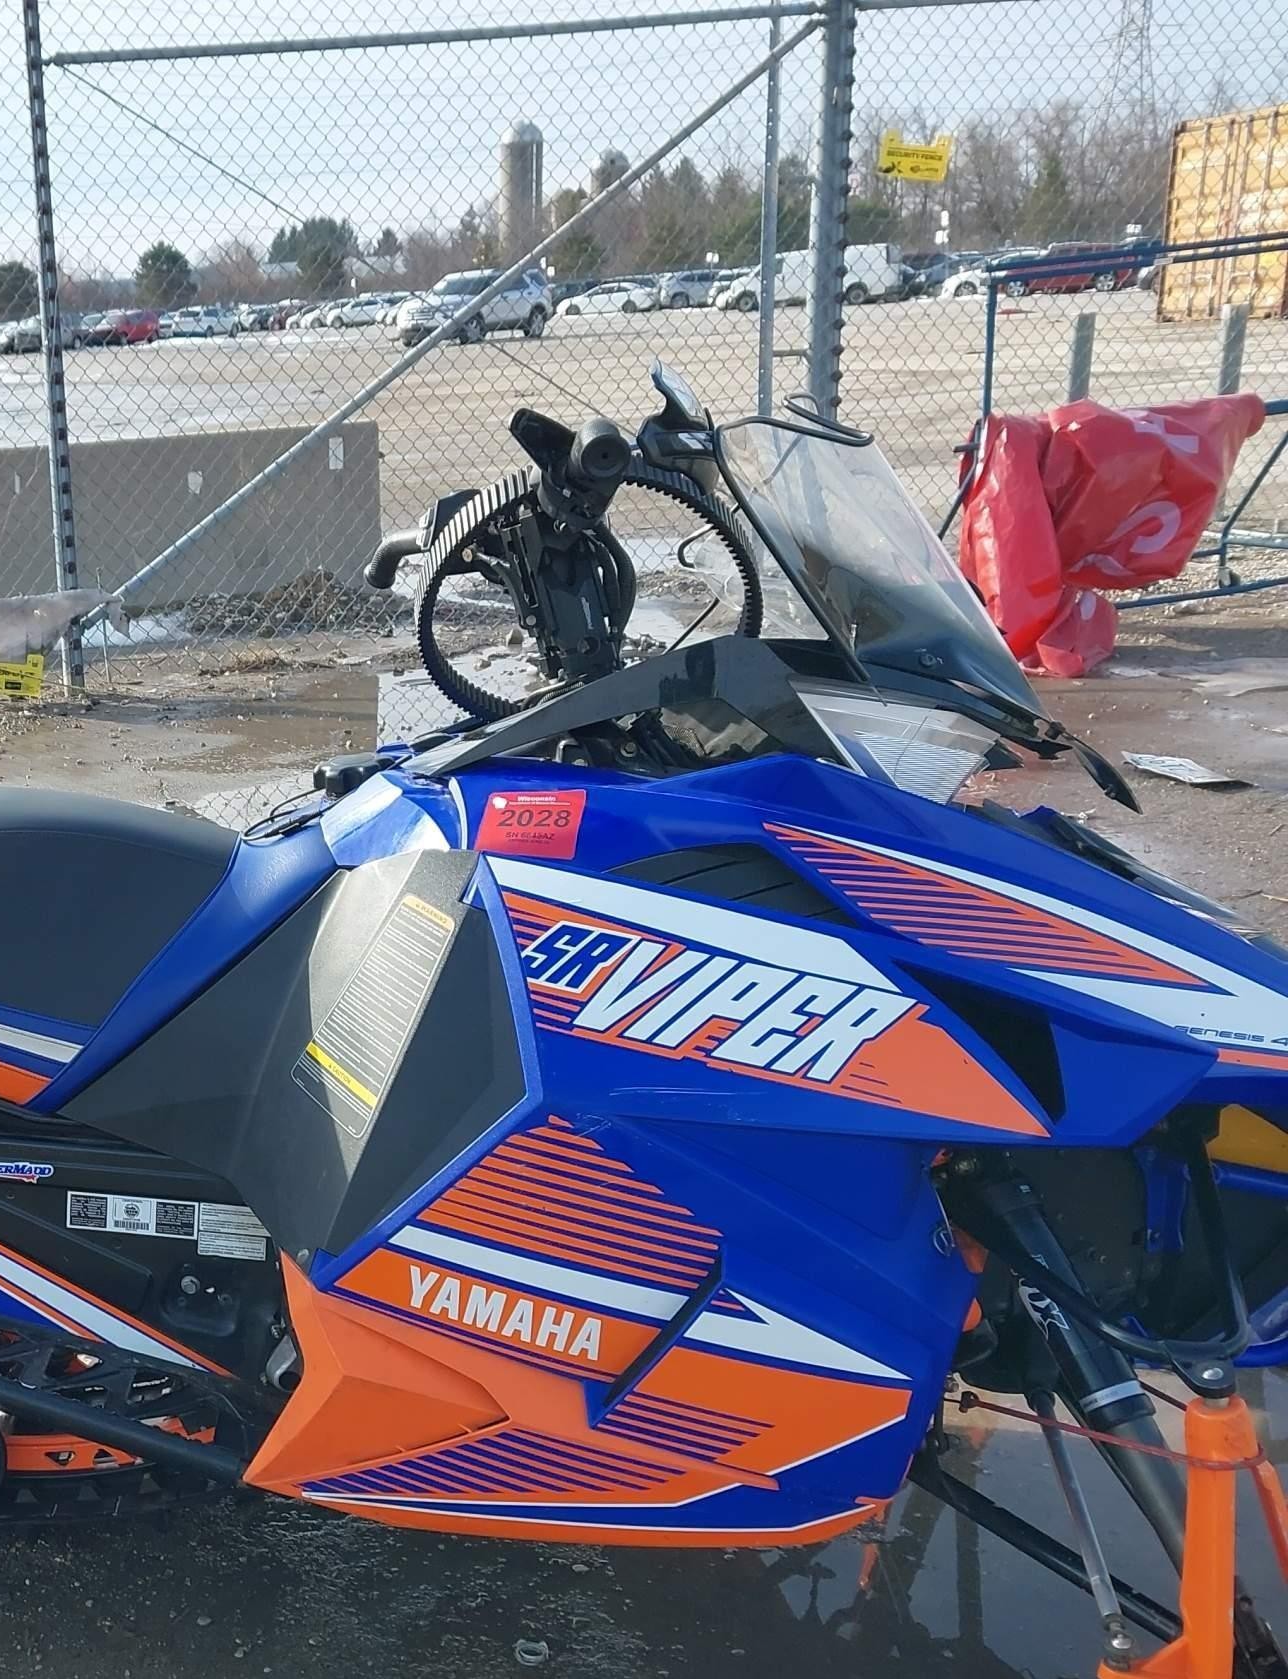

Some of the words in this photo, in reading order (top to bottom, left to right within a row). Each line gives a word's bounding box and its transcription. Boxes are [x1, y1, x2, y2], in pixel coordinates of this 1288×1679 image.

[497, 809, 571, 828] 2028
[523, 921, 639, 992] SR
[573, 940, 918, 1083] VIPER
[1174, 1025, 1265, 1043] GENESIS
[409, 1264, 602, 1361] YAMAHA
